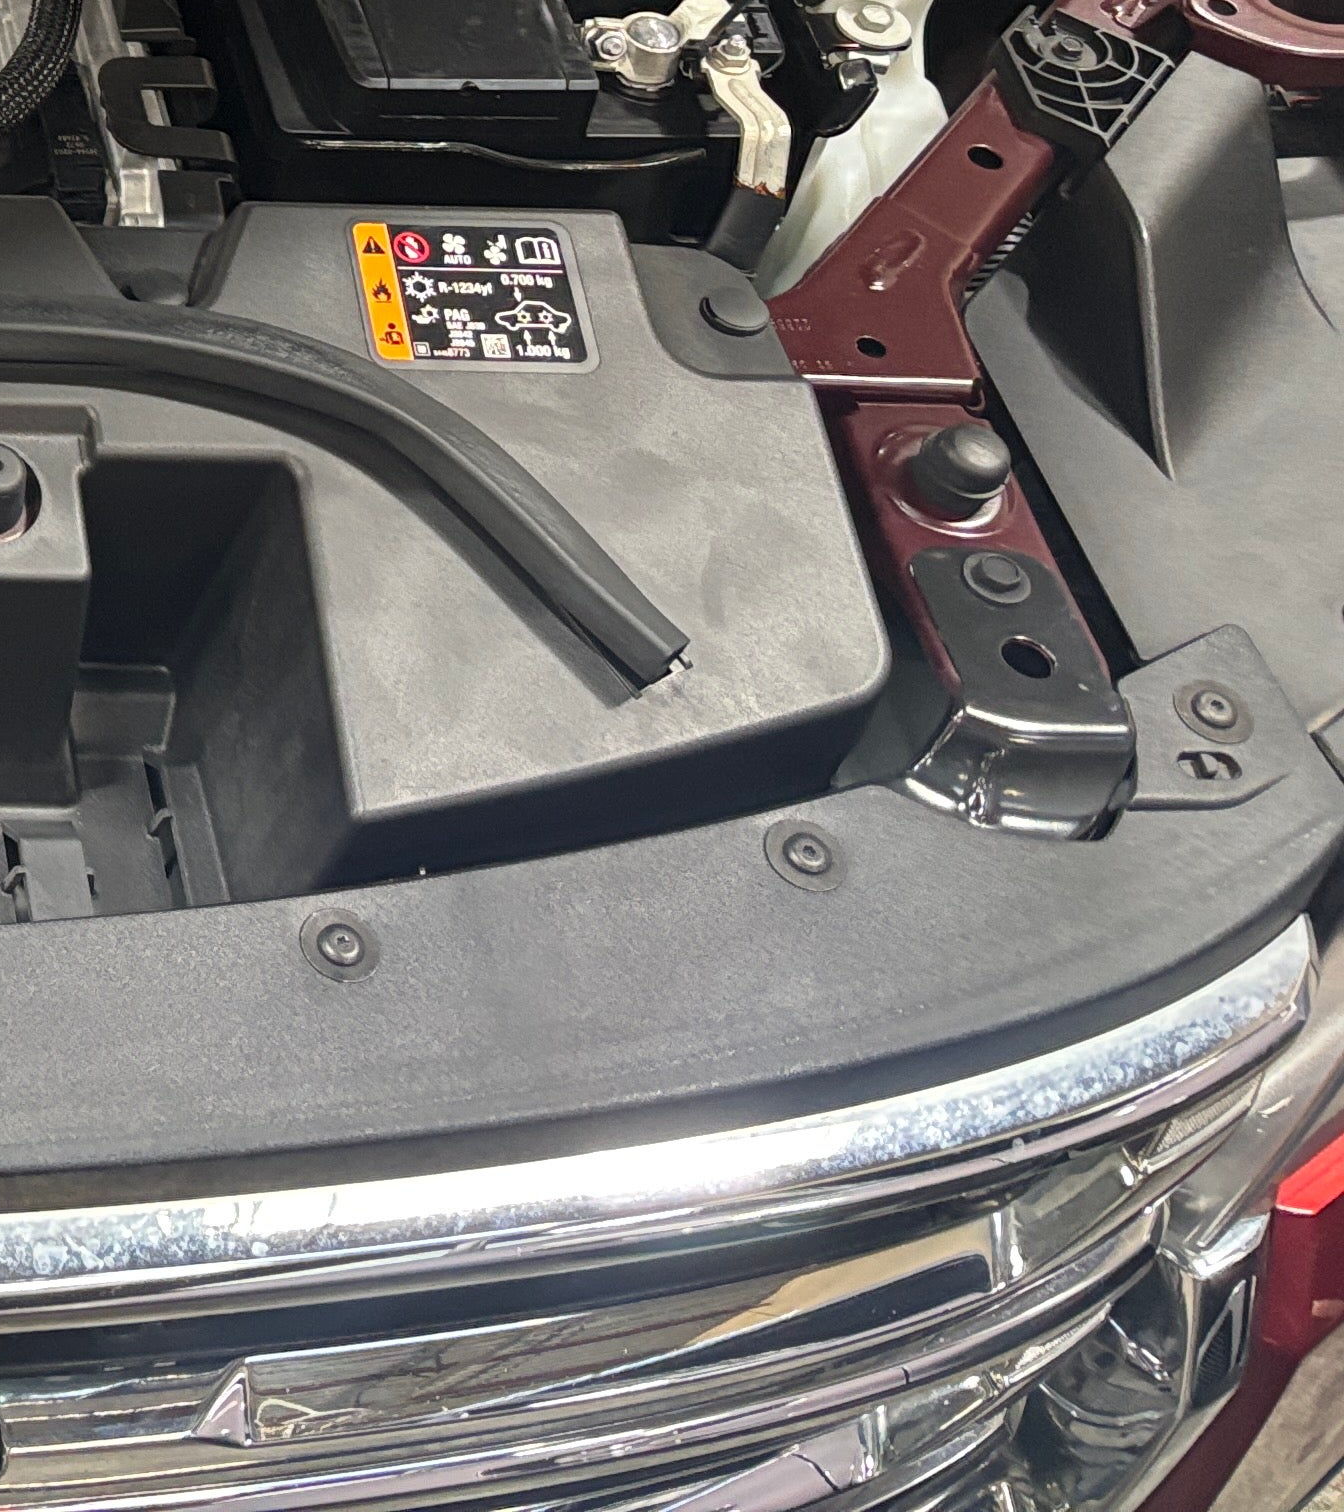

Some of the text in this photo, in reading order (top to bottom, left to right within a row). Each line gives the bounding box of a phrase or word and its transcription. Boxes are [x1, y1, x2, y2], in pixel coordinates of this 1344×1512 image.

[443, 254, 472, 265] AUTO
[500, 273, 553, 289] 0.700 kg
[443, 308, 471, 322] PAG
